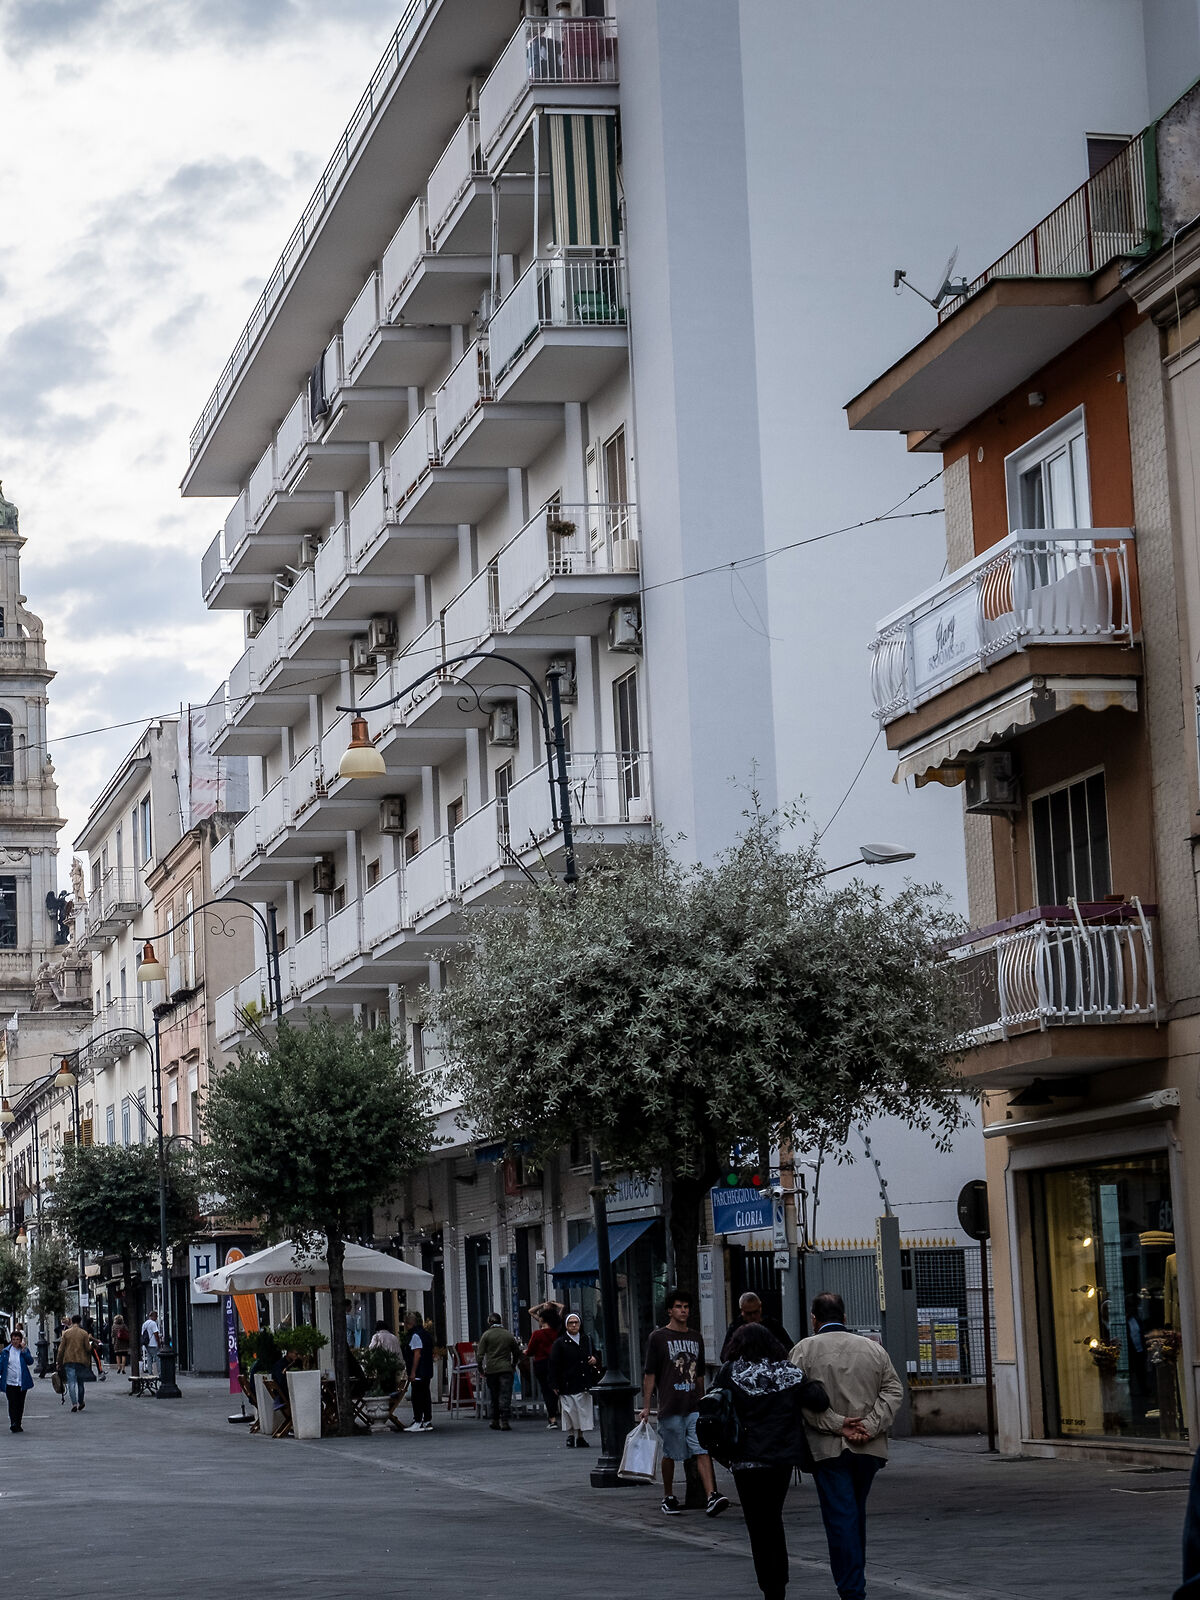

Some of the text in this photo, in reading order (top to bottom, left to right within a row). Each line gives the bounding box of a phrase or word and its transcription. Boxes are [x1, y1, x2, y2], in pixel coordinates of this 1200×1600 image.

[713, 1188, 749, 1207] PARCHEGGIO
[736, 1210, 763, 1228] GLORIA
[264, 1272, 302, 1287] Coca-Cola
